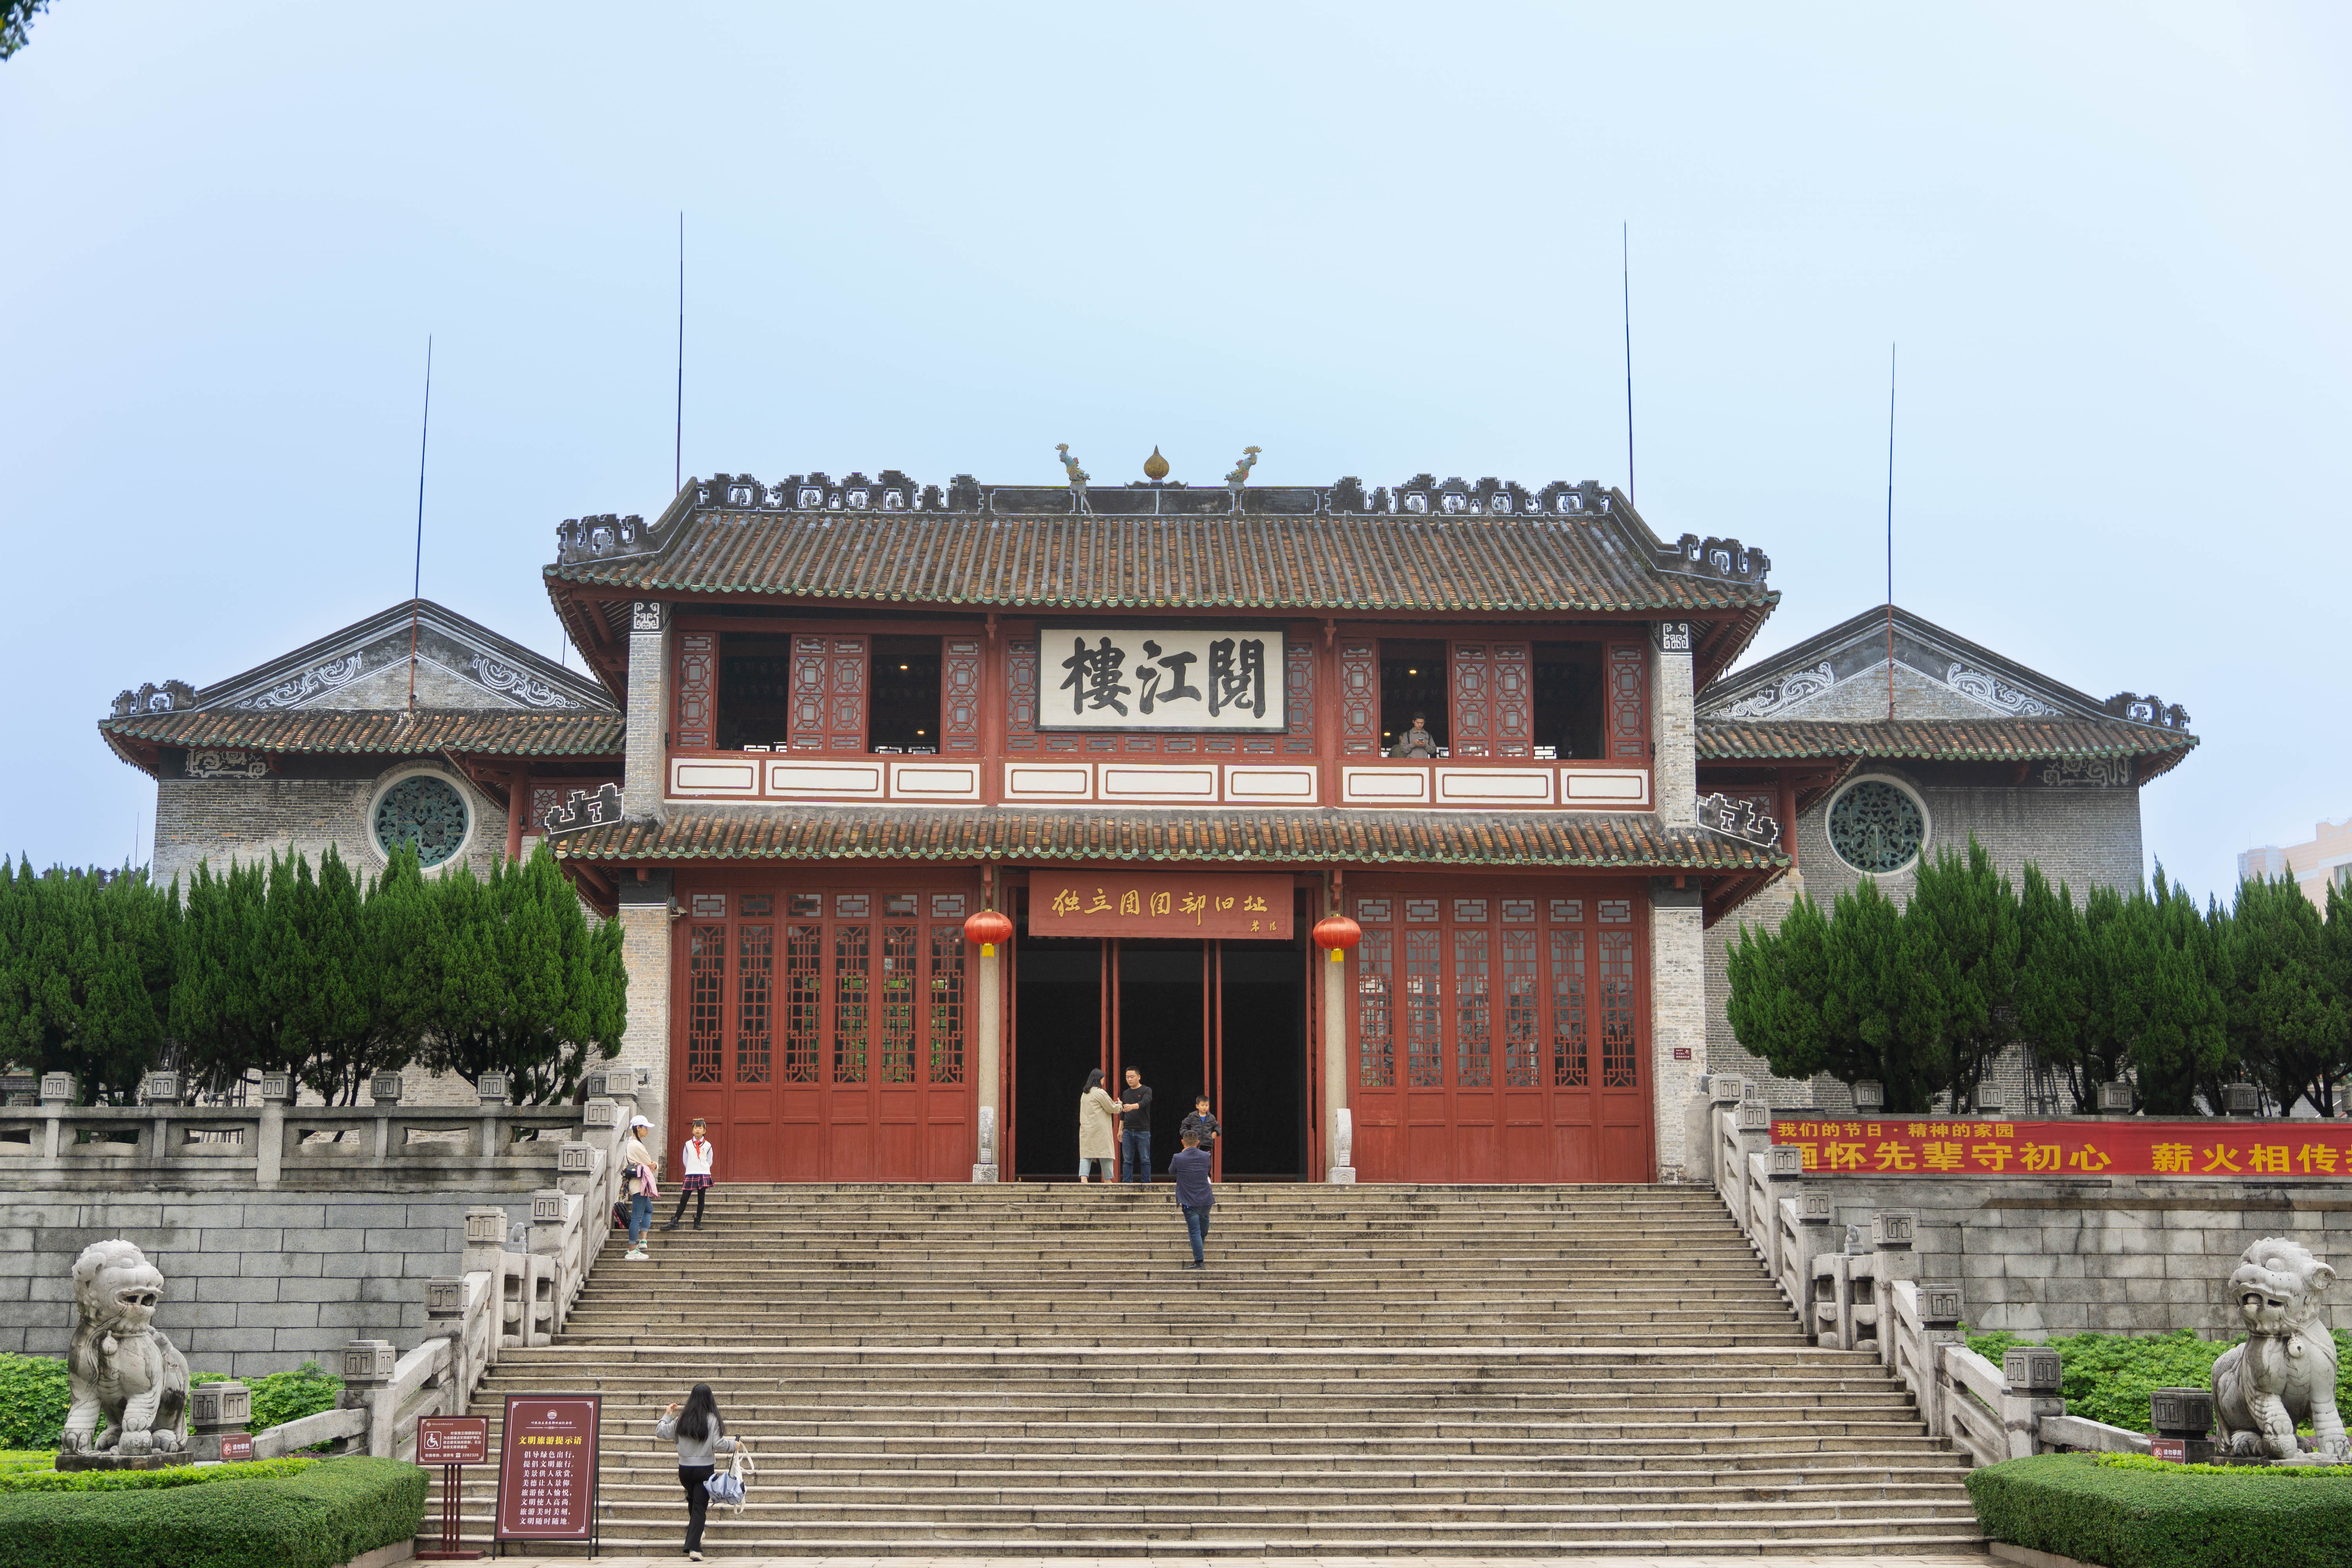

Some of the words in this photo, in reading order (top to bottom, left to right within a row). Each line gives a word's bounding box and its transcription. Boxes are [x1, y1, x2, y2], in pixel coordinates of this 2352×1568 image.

[2151, 1143, 2352, 1173] 薪火相传
[518, 1436, 582, 1445] 文明旅游提示语
